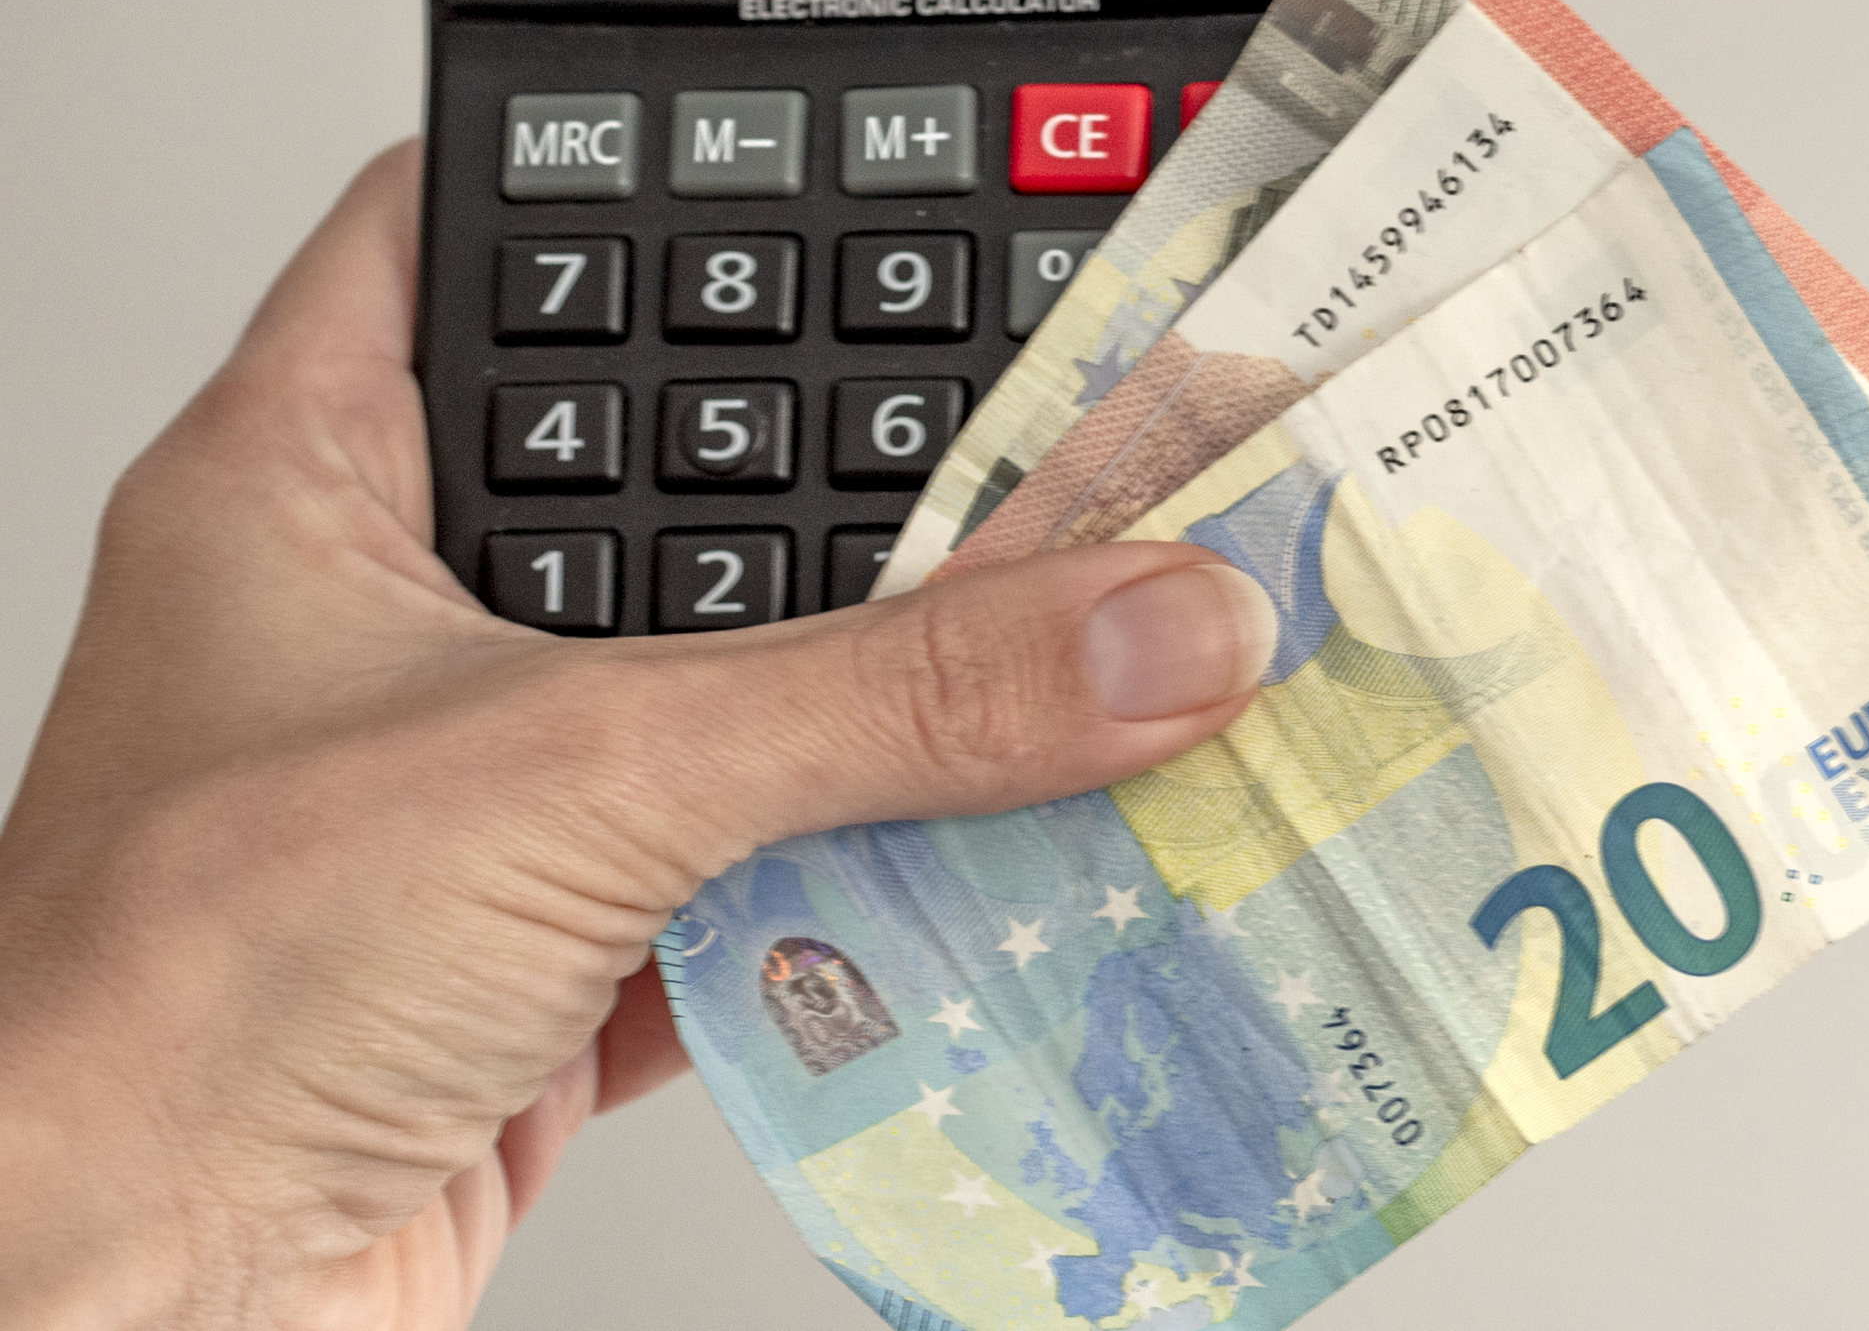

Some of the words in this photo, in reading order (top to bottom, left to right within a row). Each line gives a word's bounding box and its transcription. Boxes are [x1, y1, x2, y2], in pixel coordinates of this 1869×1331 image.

[513, 119, 623, 167] MRC
[864, 115, 950, 160] M+
[1040, 113, 1109, 159] CE
[1292, 111, 1517, 347] TD1459946134
[535, 253, 587, 314] 7
[701, 251, 757, 313] 8
[877, 251, 932, 313] 9
[1375, 276, 1648, 474] RP0817007364
[524, 401, 584, 461] 4
[697, 399, 750, 460] 5
[871, 394, 926, 457] 6
[531, 550, 565, 612] 1
[693, 550, 745, 613] 2
[1469, 781, 1764, 1080] 20
[1322, 1007, 1424, 1146] 007364
